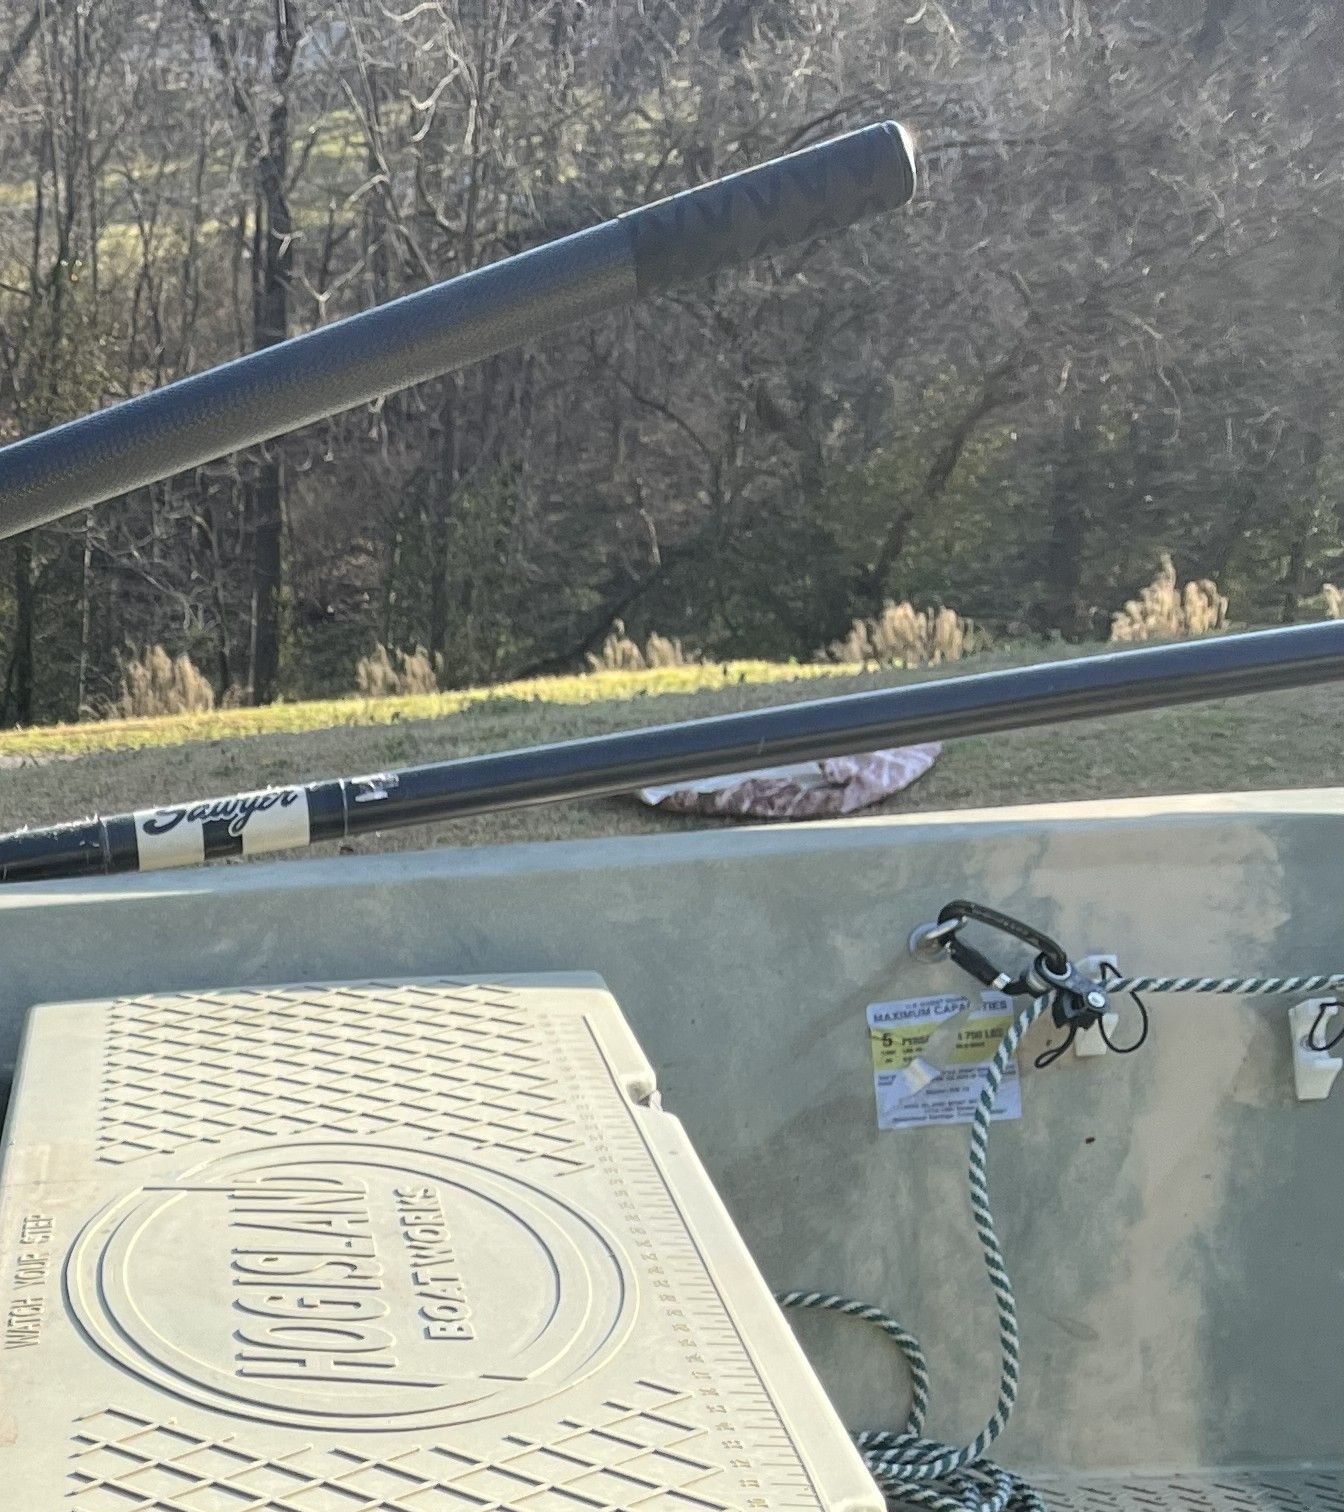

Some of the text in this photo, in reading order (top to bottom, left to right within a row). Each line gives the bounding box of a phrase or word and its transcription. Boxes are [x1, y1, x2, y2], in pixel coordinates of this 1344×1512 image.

[142, 789, 298, 836] Sawyer
[873, 1007, 931, 1022] MAXIMUM
[4, 1213, 56, 1350] WATCH YOUR STEP
[230, 1174, 412, 1387] HOG ISLAND
[394, 1185, 475, 1341] BOAT WORKS
